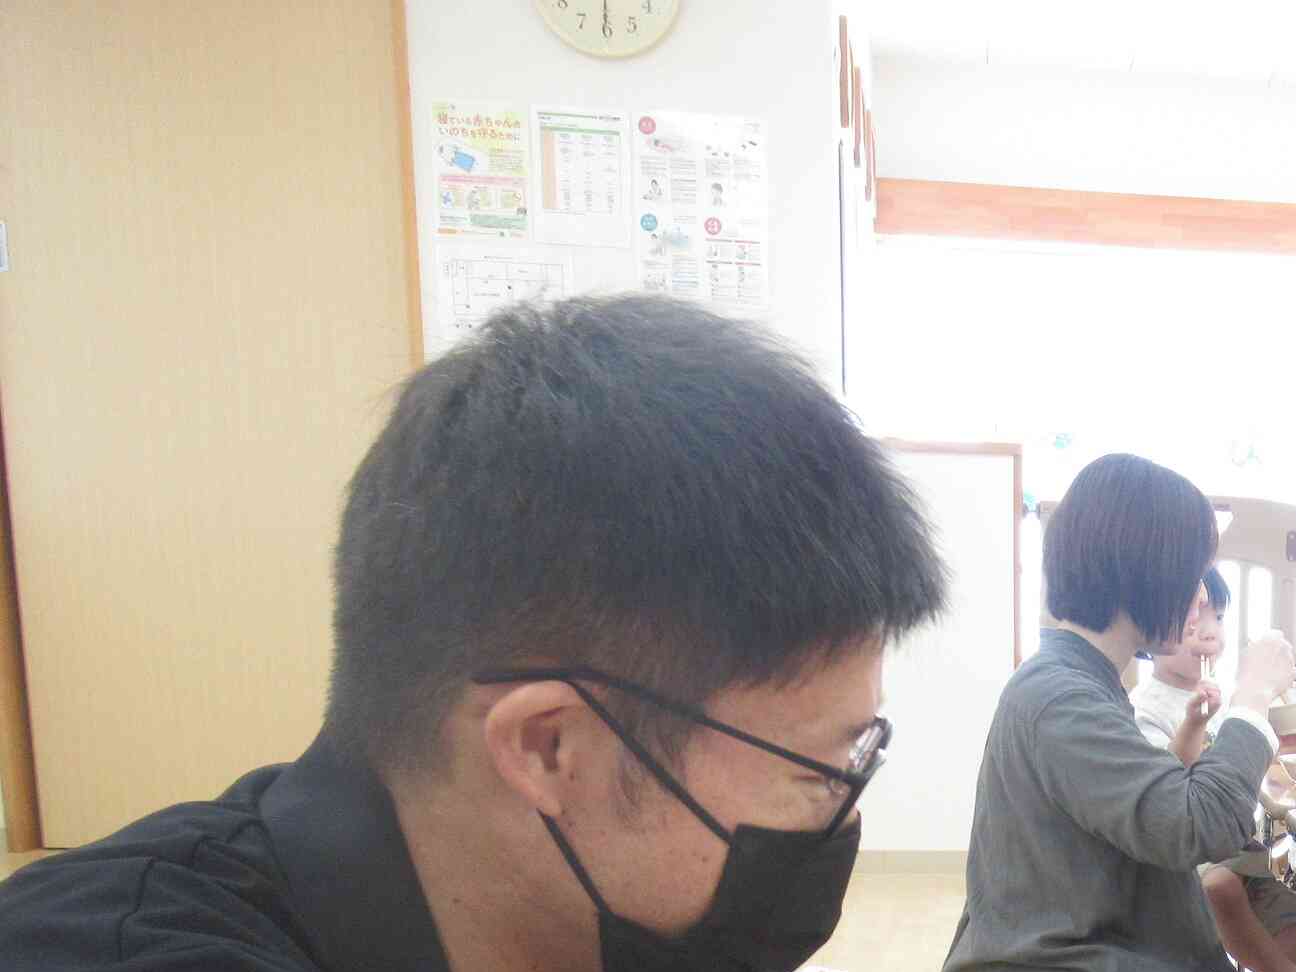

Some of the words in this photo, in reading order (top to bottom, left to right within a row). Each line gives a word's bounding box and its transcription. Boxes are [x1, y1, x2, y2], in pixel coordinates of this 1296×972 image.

[576, 13, 586, 30] 7
[627, 16, 637, 33] 5
[602, 24, 613, 38] 6
